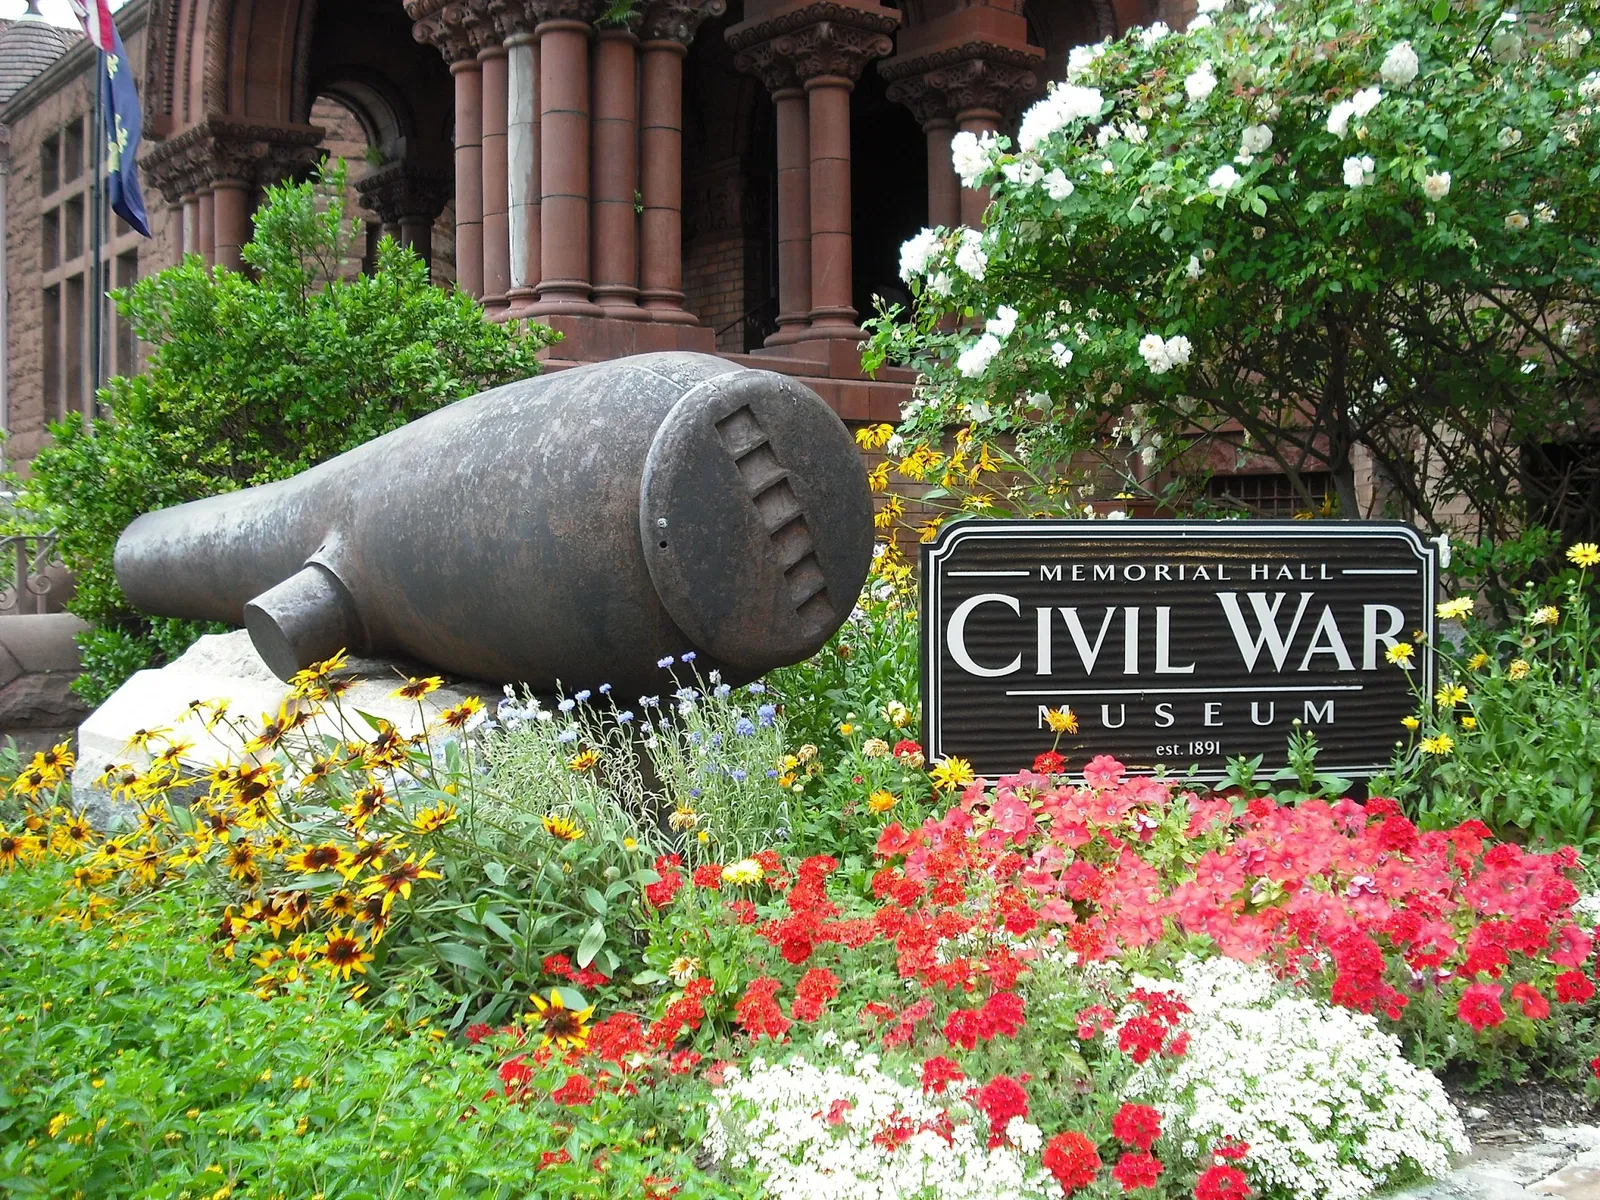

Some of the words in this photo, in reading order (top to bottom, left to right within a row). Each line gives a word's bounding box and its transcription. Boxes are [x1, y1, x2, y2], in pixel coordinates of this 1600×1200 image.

[1039, 564, 1231, 582] MEMORIAL
[1251, 563, 1334, 581] HALL
[946, 593, 1196, 677] CIVIL
[1215, 591, 1416, 675] WAR
[1155, 742, 1184, 756] est.
[1188, 740, 1221, 756] 1891
